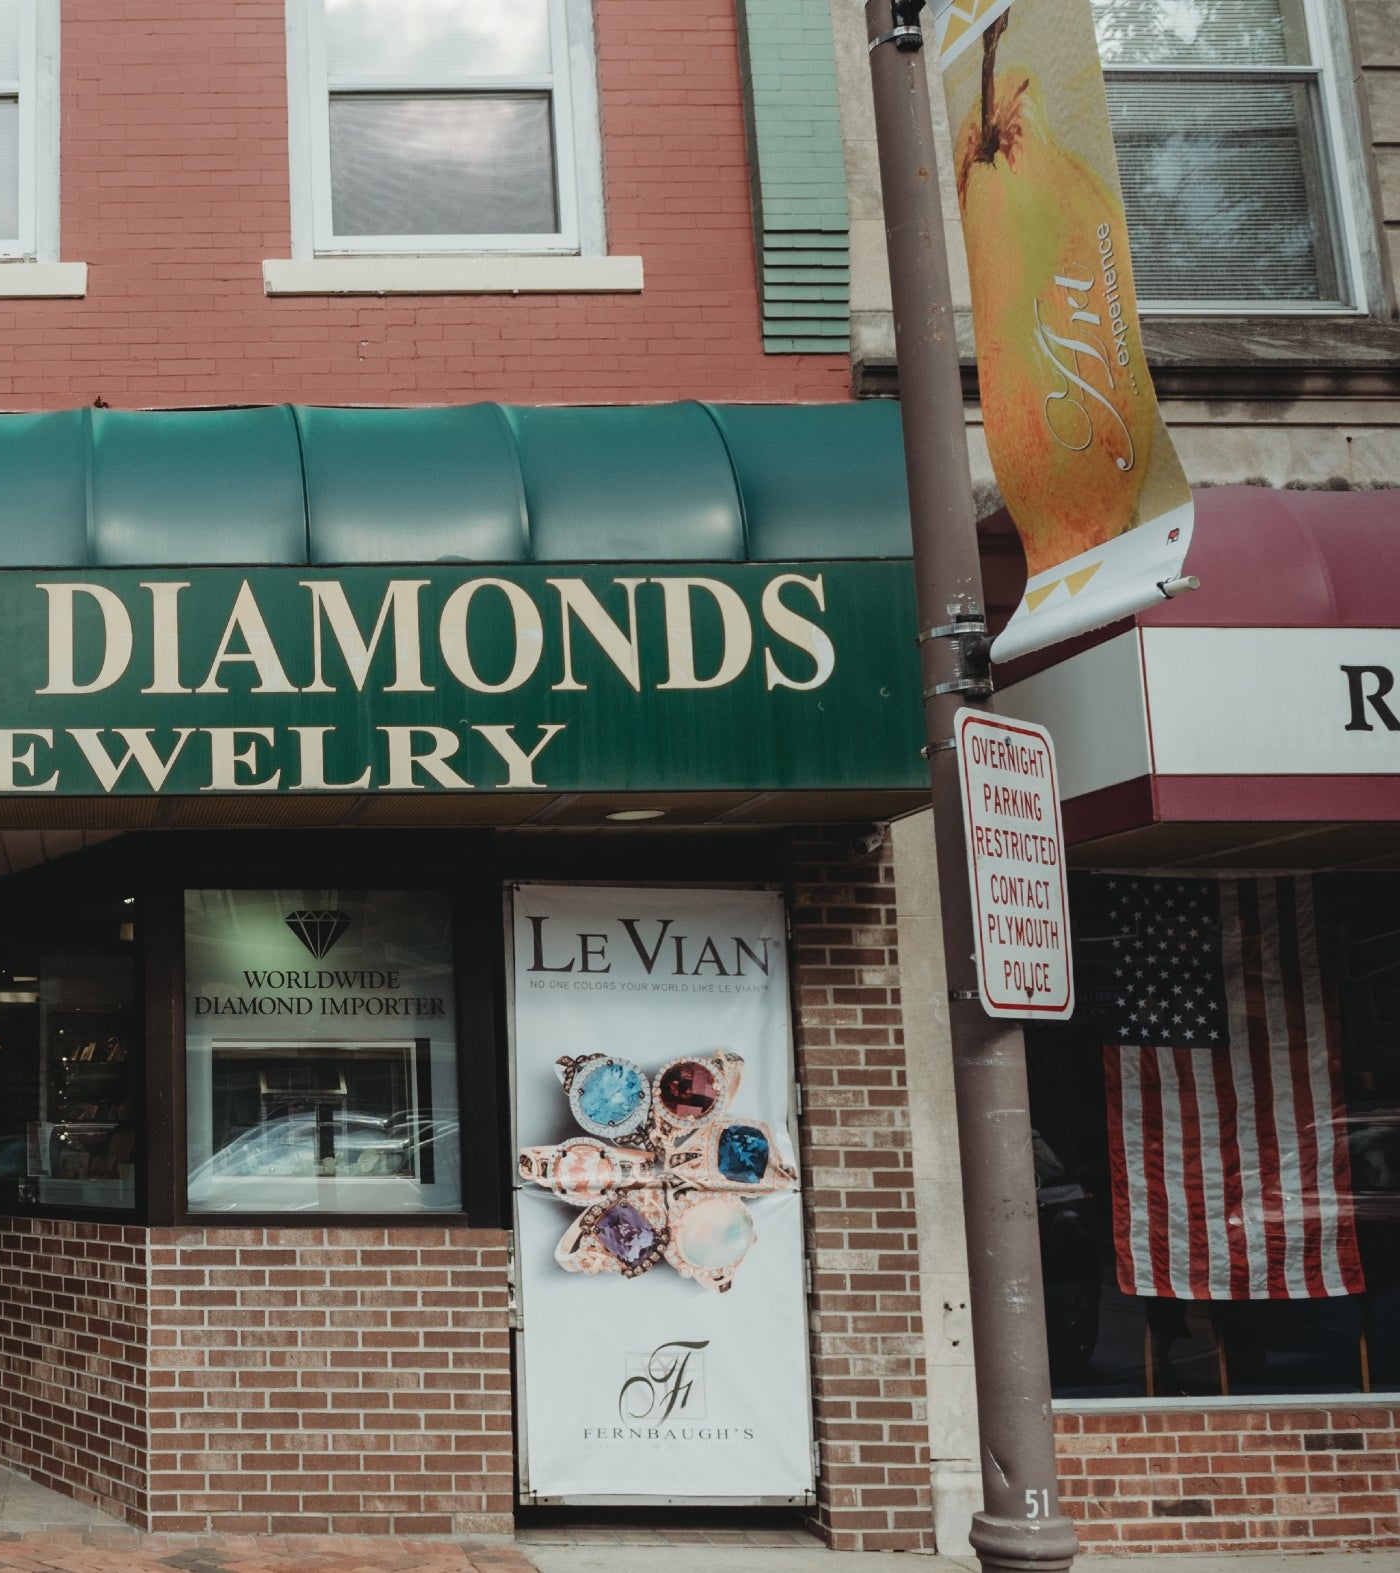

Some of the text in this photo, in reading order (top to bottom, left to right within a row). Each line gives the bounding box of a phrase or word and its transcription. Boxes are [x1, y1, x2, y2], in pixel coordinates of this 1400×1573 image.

[1034, 263, 1134, 471] Art
[35, 573, 836, 695] DIAMONDS
[971, 734, 1045, 778] OVERNIGHT
[983, 783, 1042, 822] PARKING
[976, 825, 1057, 866] RESTRICTED
[990, 873, 1050, 910] CONTACT
[988, 914, 1059, 950] PLYMOUTH
[243, 970, 401, 989] WORLDWIDE
[530, 980, 545, 989] NO
[550, 980, 569, 989] ONE
[573, 980, 616, 991] COLORS
[620, 982, 648, 992] YOUR
[652, 983, 689, 992] WORLD
[692, 983, 715, 993] LIKE
[719, 983, 733, 993] LE
[1004, 959, 1052, 993] POLICE
[195, 996, 448, 1017] DIAMOND IMPORTER
[584, 1428, 754, 1440] FERNBAUGH'S
[1025, 1488, 1049, 1519] 51
